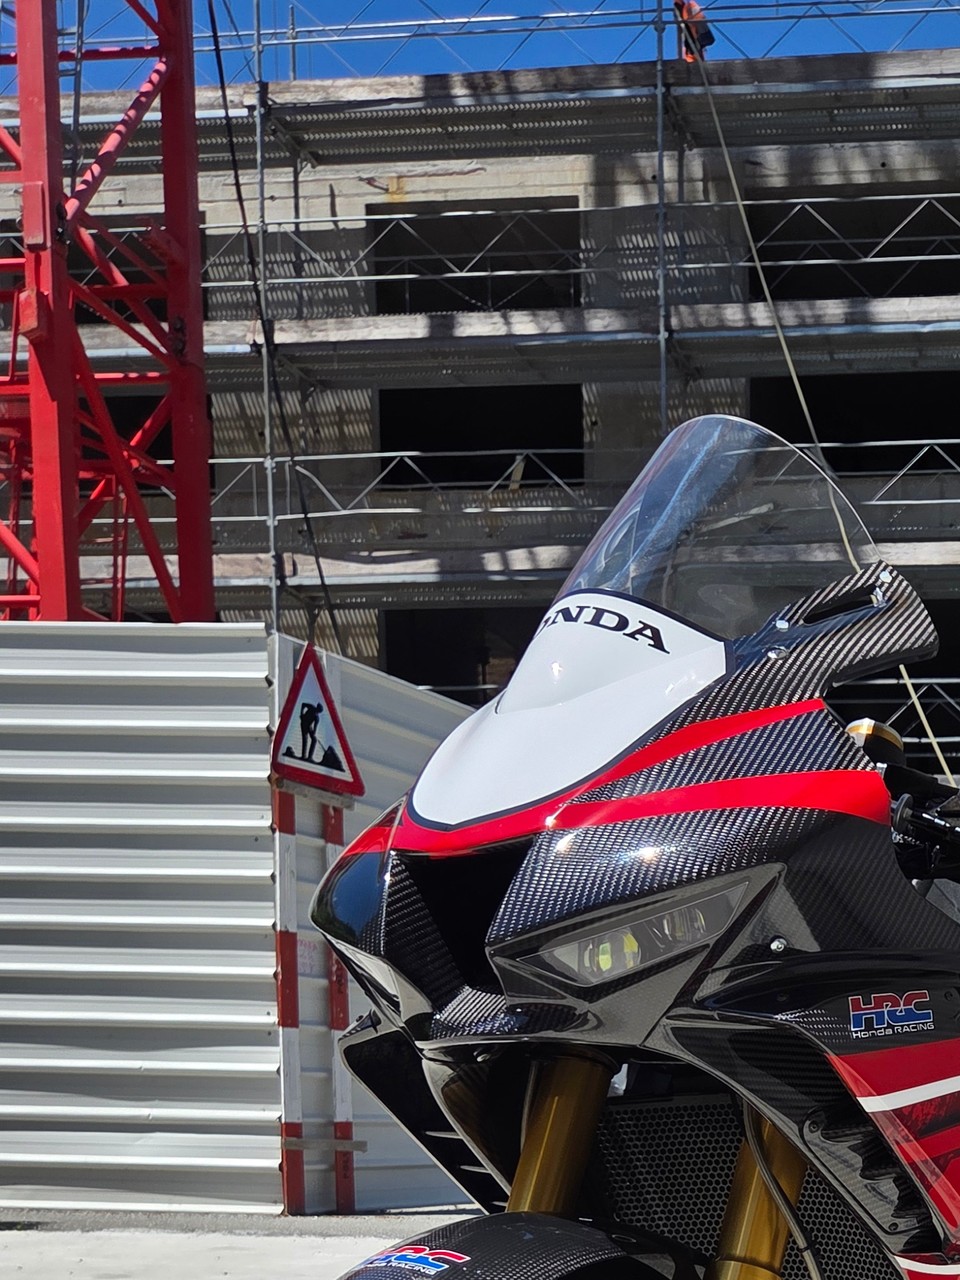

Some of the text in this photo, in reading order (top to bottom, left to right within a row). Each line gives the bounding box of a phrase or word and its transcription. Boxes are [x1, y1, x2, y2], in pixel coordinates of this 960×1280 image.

[538, 605, 670, 655] NDA
[848, 990, 933, 1031] HRC
[852, 1023, 935, 1039] Honda RACING
[387, 1262, 438, 1275] RACING
